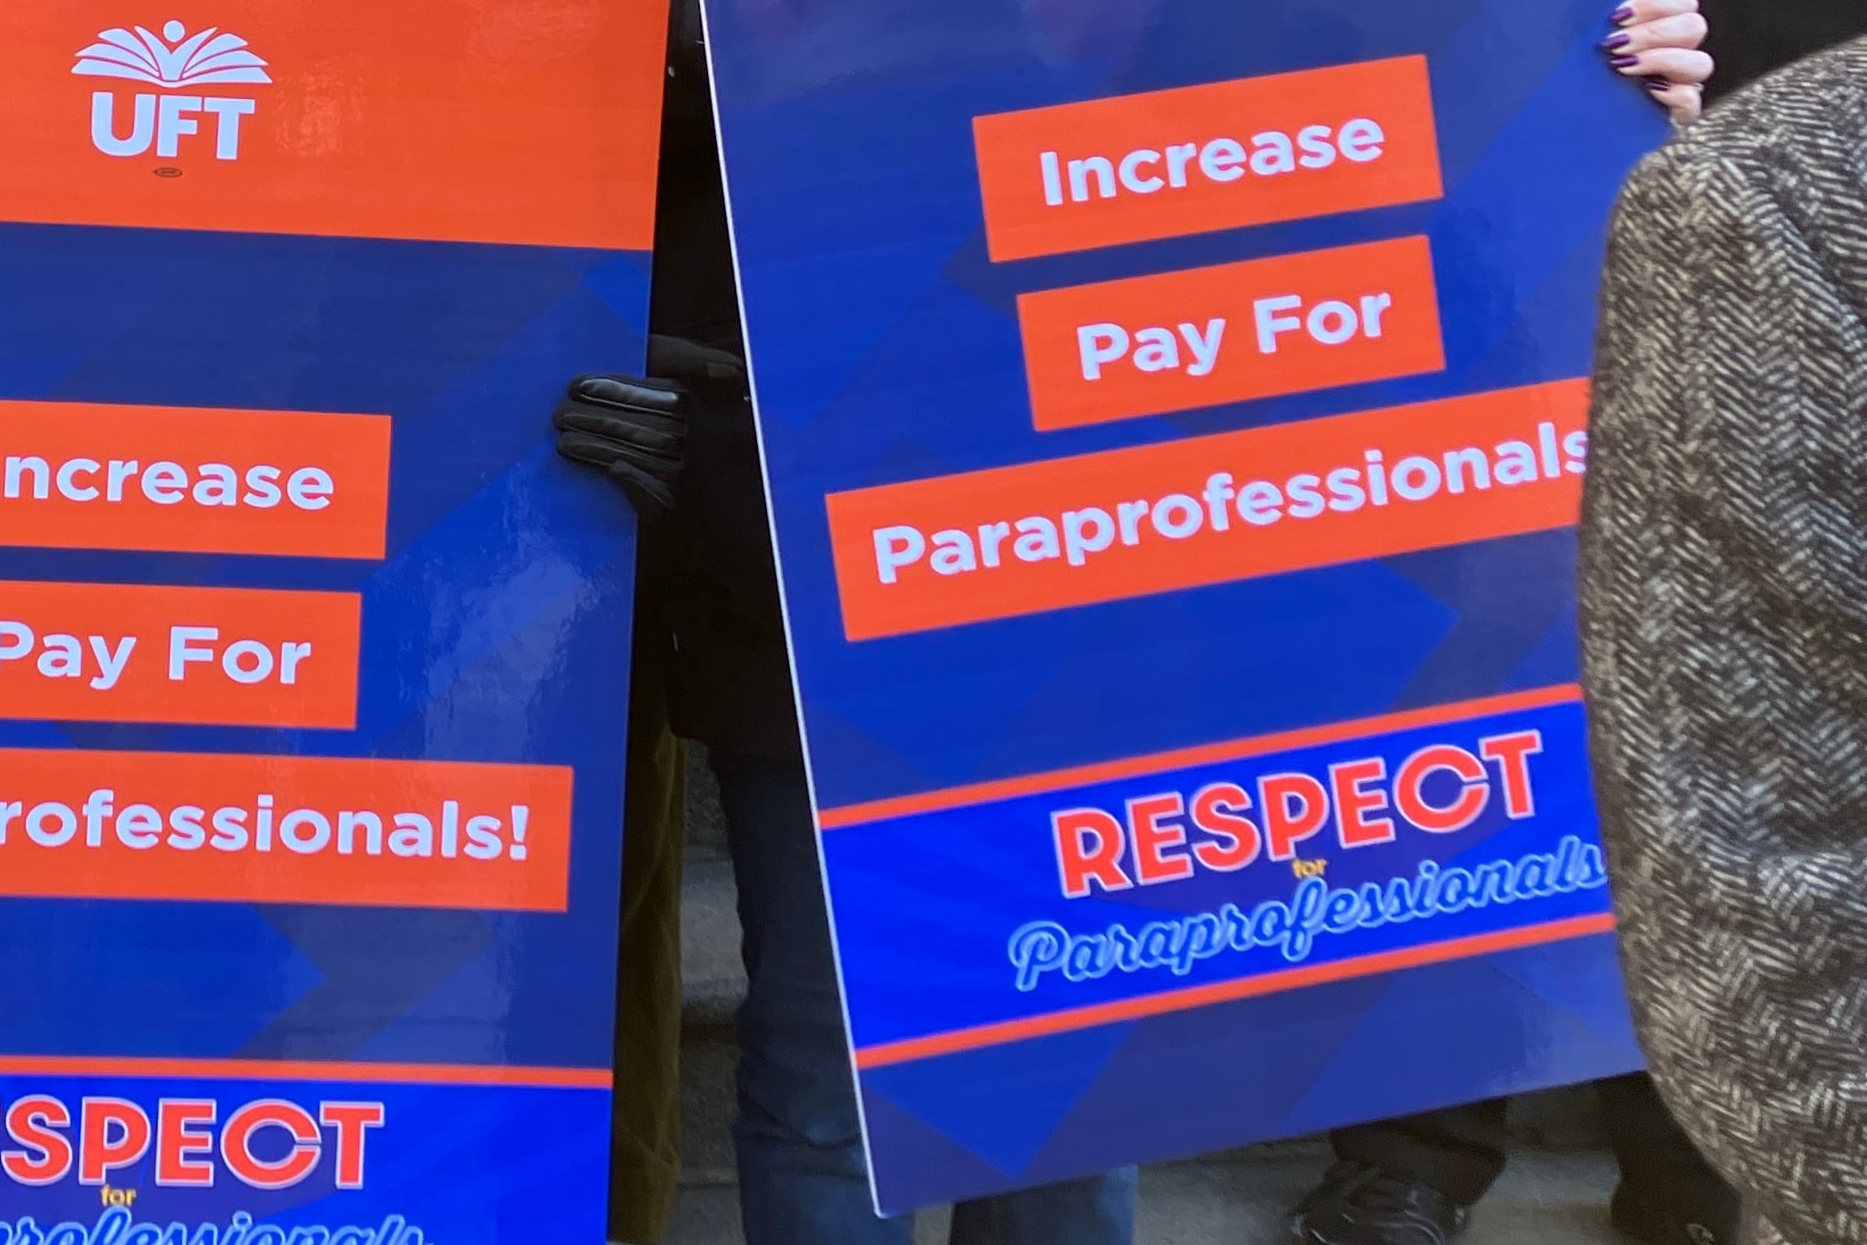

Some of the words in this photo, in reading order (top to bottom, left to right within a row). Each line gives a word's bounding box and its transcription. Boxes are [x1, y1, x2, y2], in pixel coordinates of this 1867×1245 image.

[91, 91, 256, 161] UFT
[1039, 117, 1385, 207] Increase
[1076, 317, 1226, 381] Pay
[1252, 292, 1392, 354] For
[167, 625, 312, 685] For
[1050, 729, 1543, 900] RESPECT
[1291, 857, 1328, 879] for
[1007, 834, 1608, 993] Paraprofessionals
[100, 1184, 137, 1207] for
